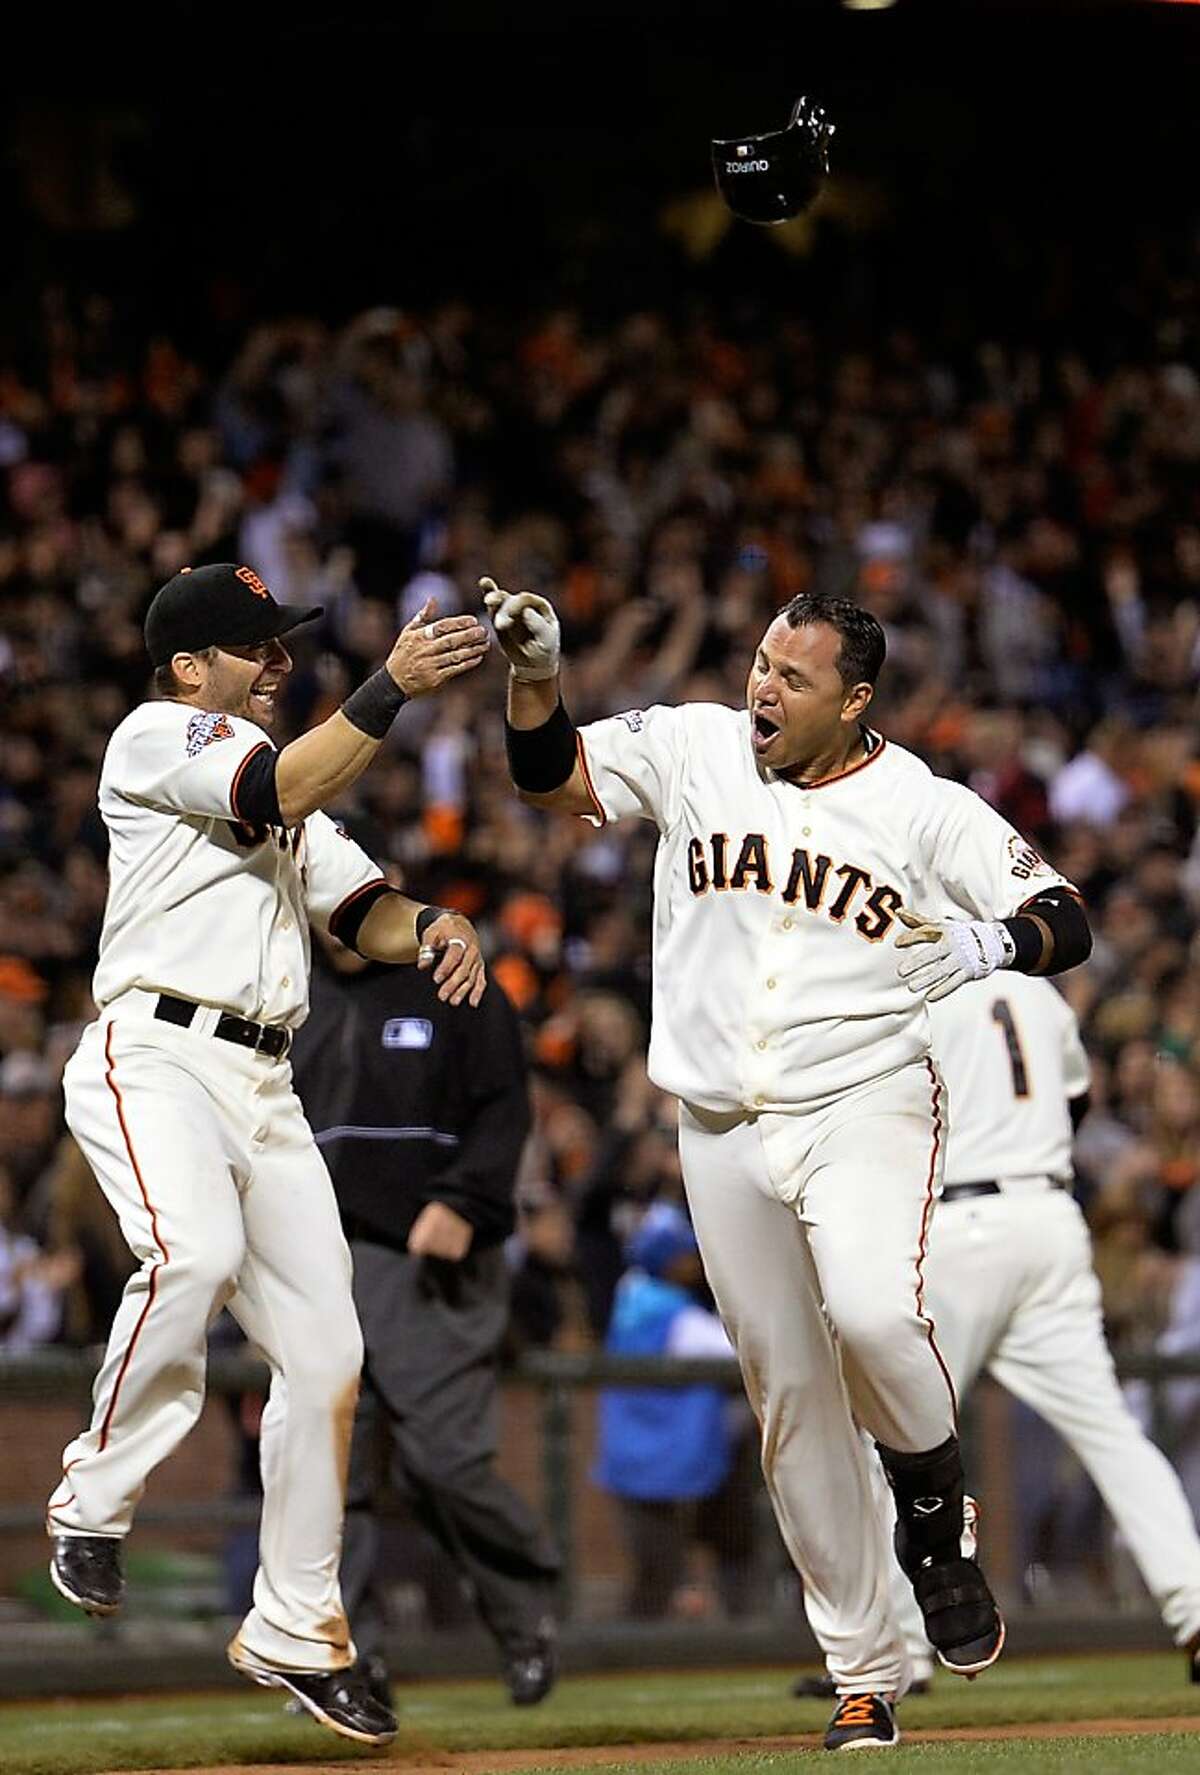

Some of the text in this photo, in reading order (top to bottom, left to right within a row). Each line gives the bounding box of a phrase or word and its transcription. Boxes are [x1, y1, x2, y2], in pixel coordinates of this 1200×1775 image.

[726, 160, 769, 173] QUIROZ
[687, 832, 904, 944] GIANTS
[991, 998, 1031, 1101] 1
